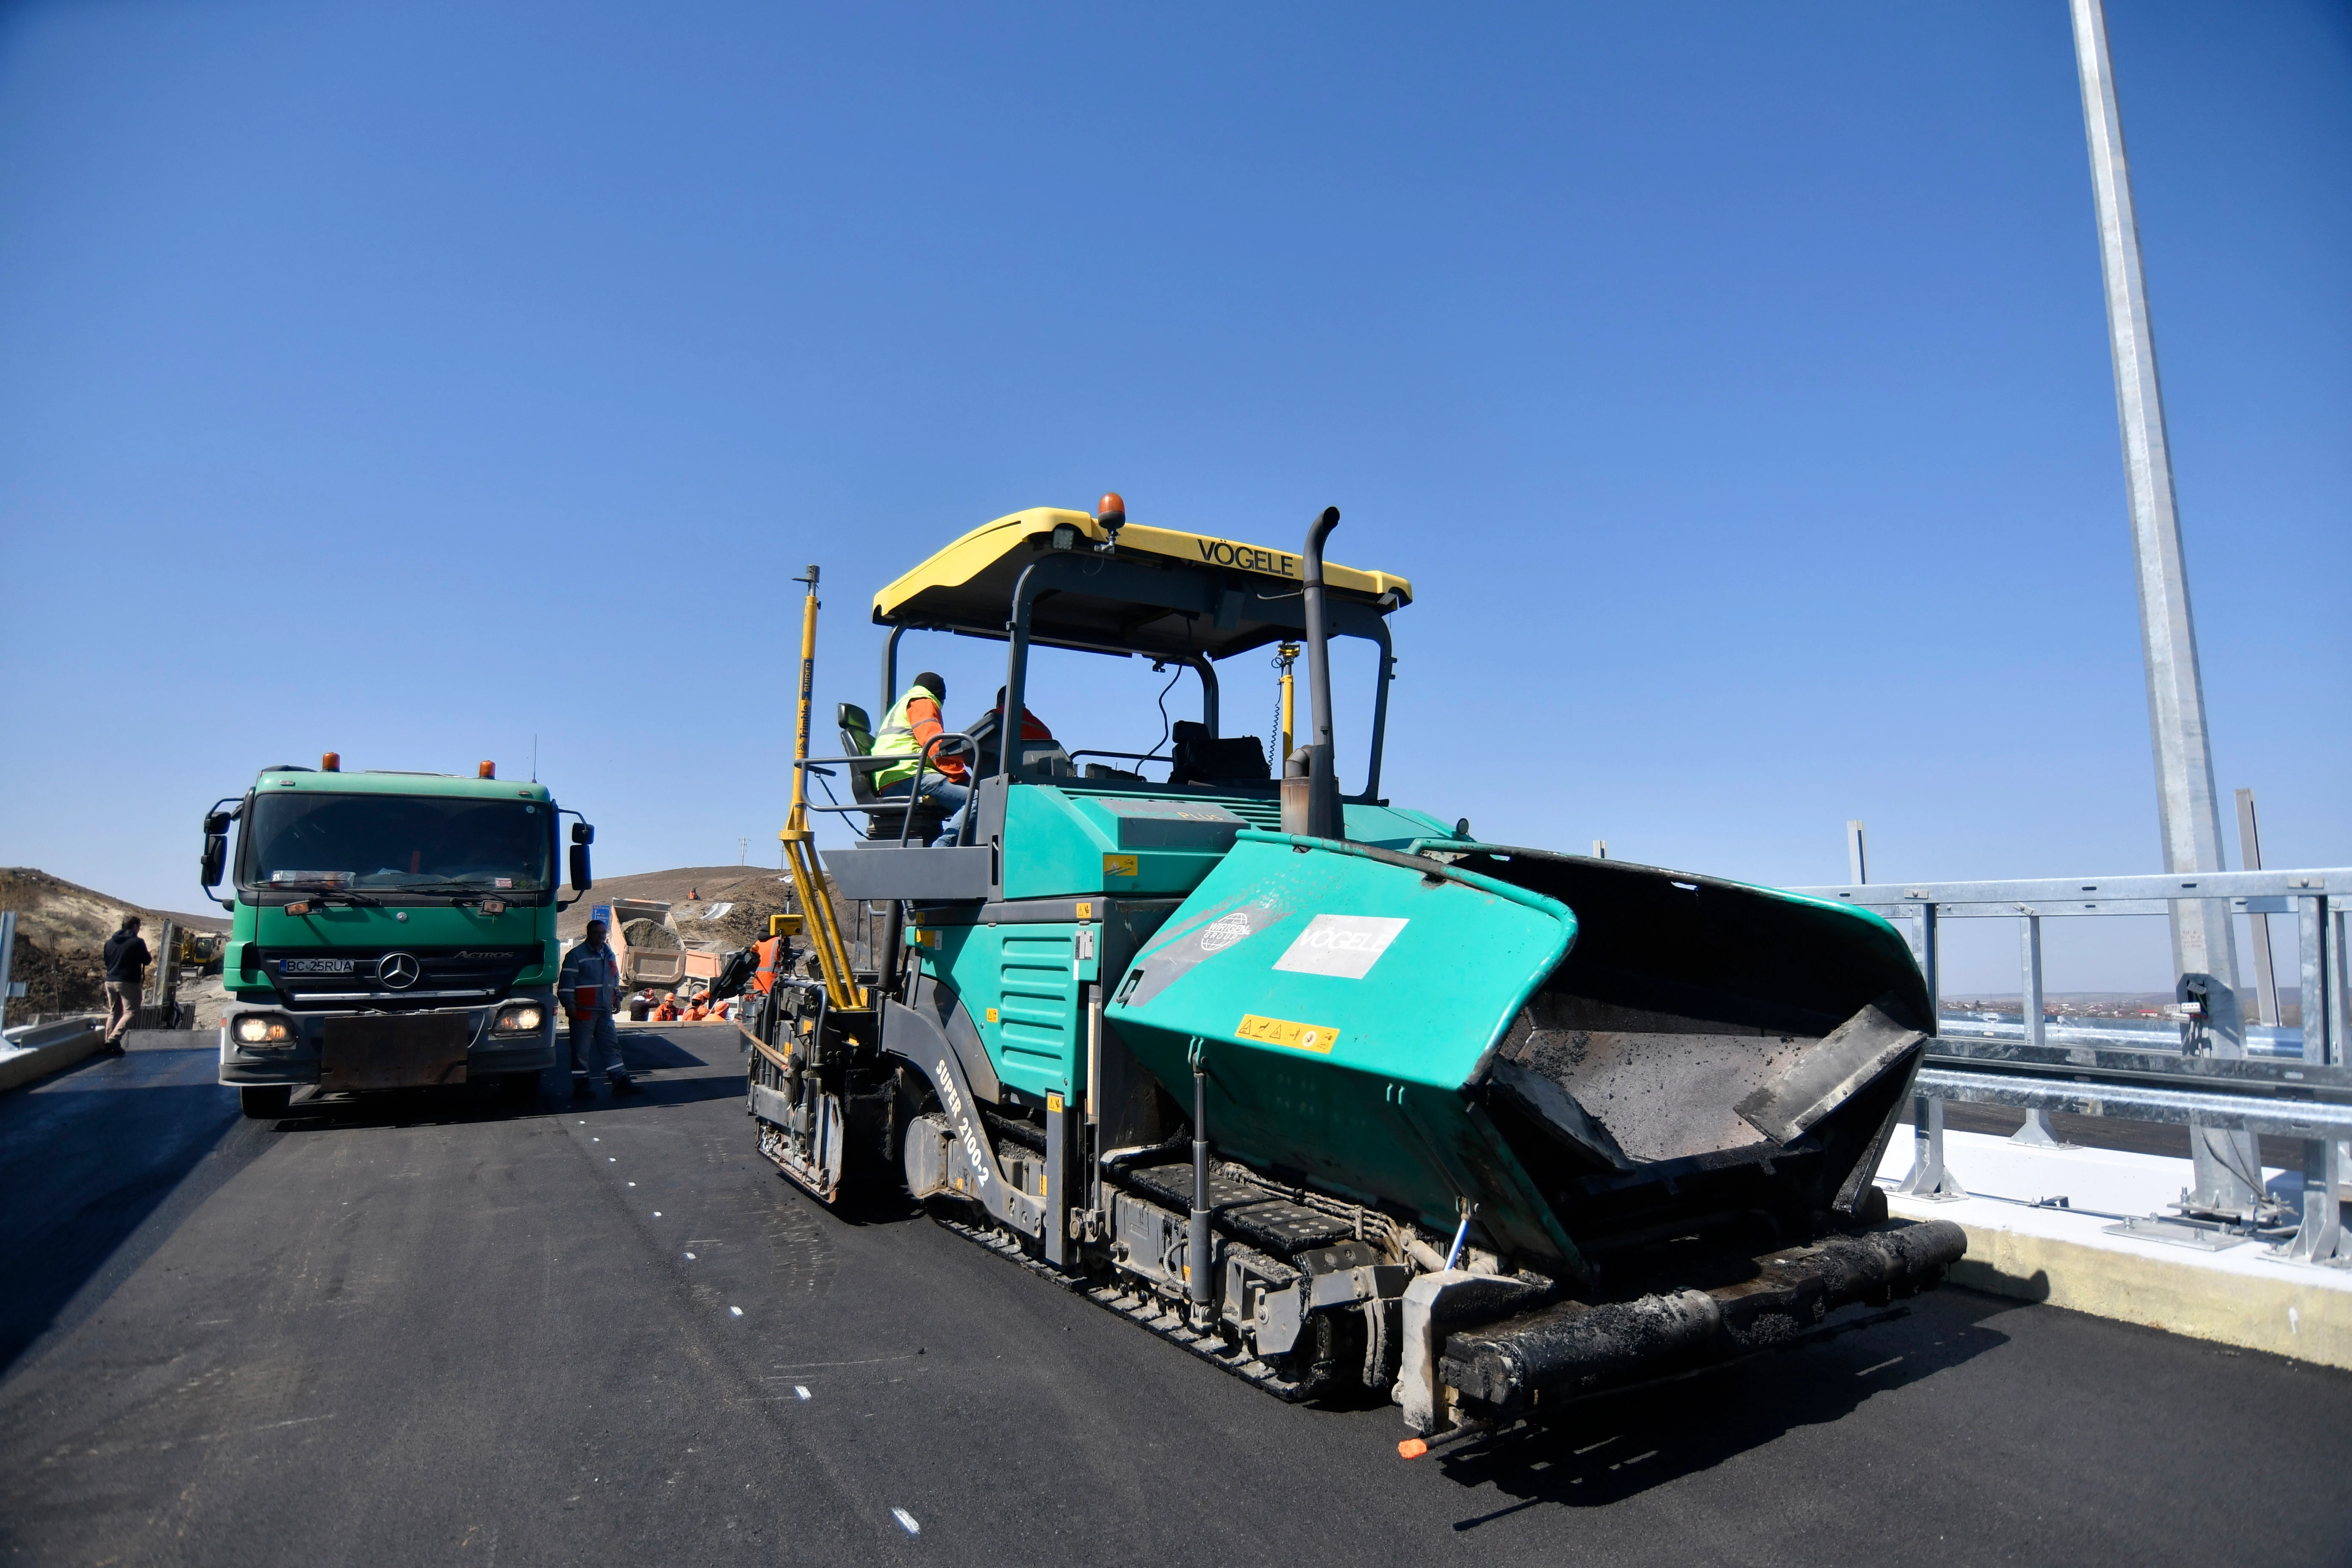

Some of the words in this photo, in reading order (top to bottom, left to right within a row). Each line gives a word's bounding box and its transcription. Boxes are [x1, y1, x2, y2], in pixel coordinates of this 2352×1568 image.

[1197, 538, 1294, 577] VÖGELE
[799, 704, 810, 740] Trimble
[1203, 931, 1238, 940] GROUP
[1208, 922, 1249, 933] WIRTGEN
[1299, 926, 1392, 953] VÖGELE
[936, 1059, 962, 1119] SUPER
[958, 1116, 989, 1188] 2100-2
